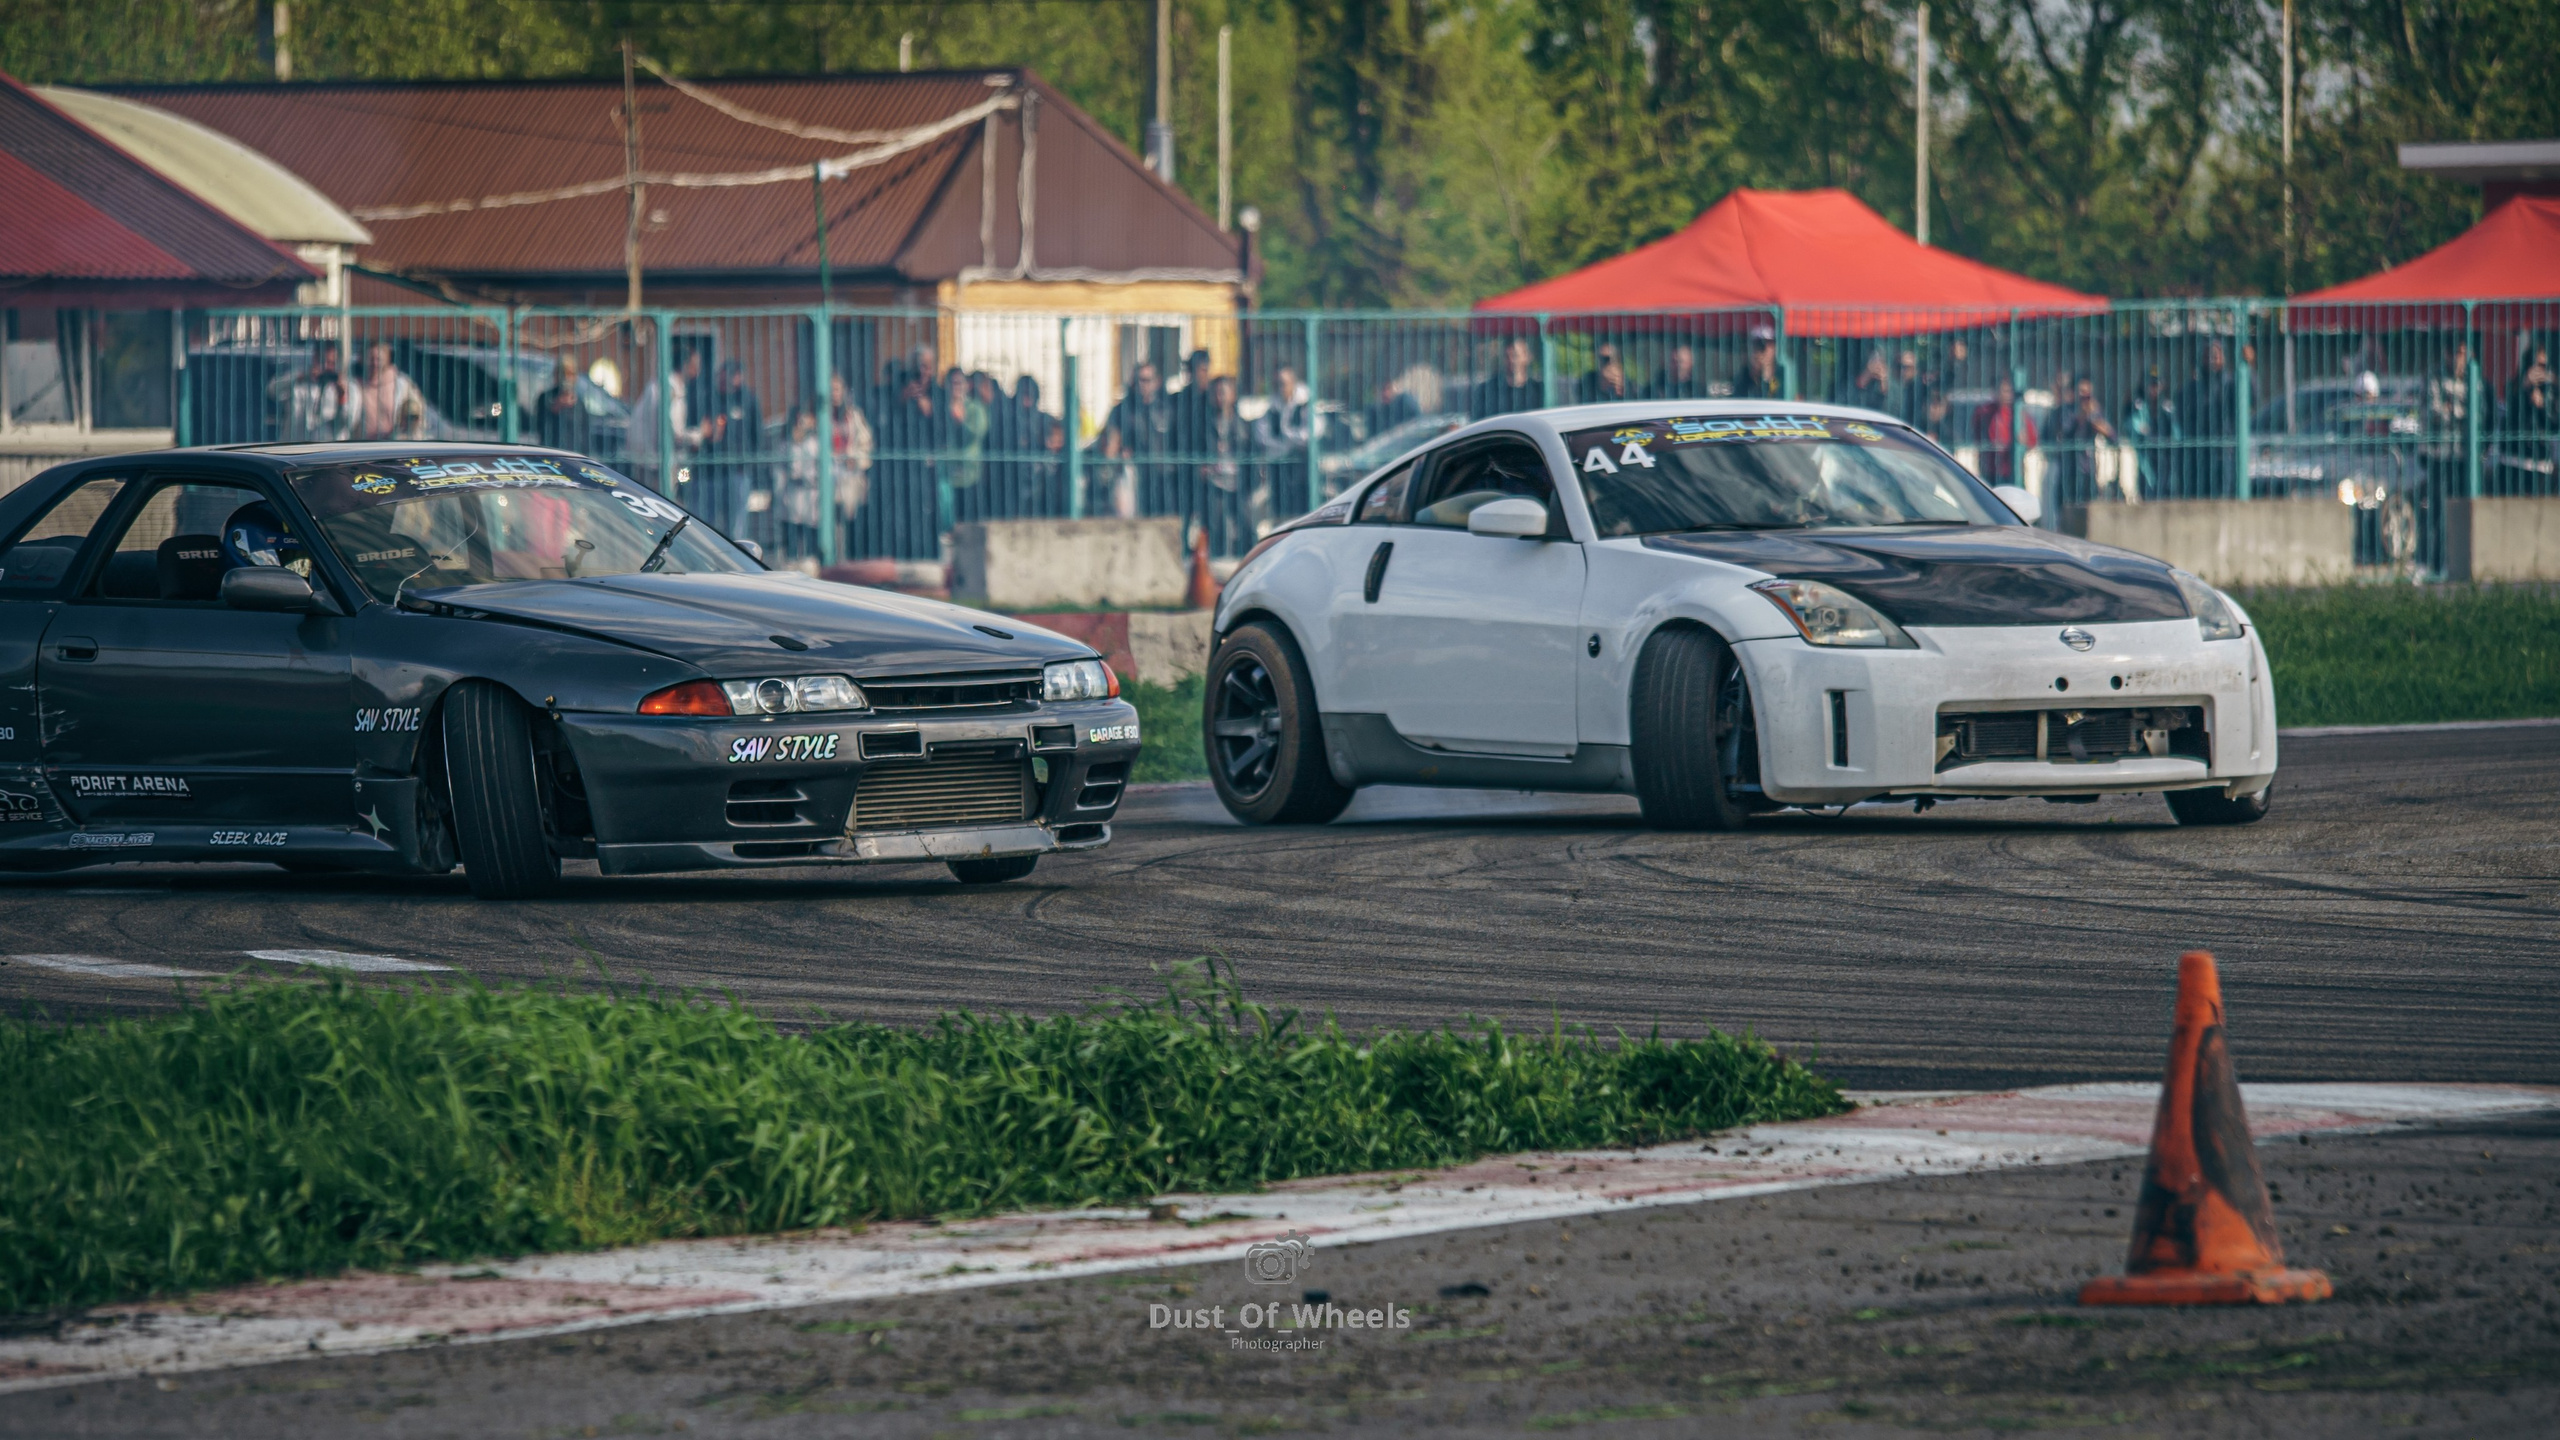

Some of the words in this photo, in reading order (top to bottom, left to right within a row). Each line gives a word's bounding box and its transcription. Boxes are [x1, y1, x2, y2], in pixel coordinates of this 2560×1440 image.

[1583, 443, 1656, 475] 44
[426, 474, 489, 487] DRIFT
[611, 490, 685, 523] 30
[176, 549, 219, 560] BRID
[355, 547, 416, 563] BRIDE
[354, 707, 380, 732] SAV
[381, 707, 421, 732] STYLE
[1089, 725, 1124, 743] GARAGE
[728, 736, 773, 763] SAV
[774, 734, 840, 761] STYLE
[79, 775, 127, 791] DRIFT
[133, 776, 190, 792] ARENA
[8, 812, 44, 822] SERVICE
[209, 830, 251, 845] SLEEK
[253, 831, 288, 846] RACE
